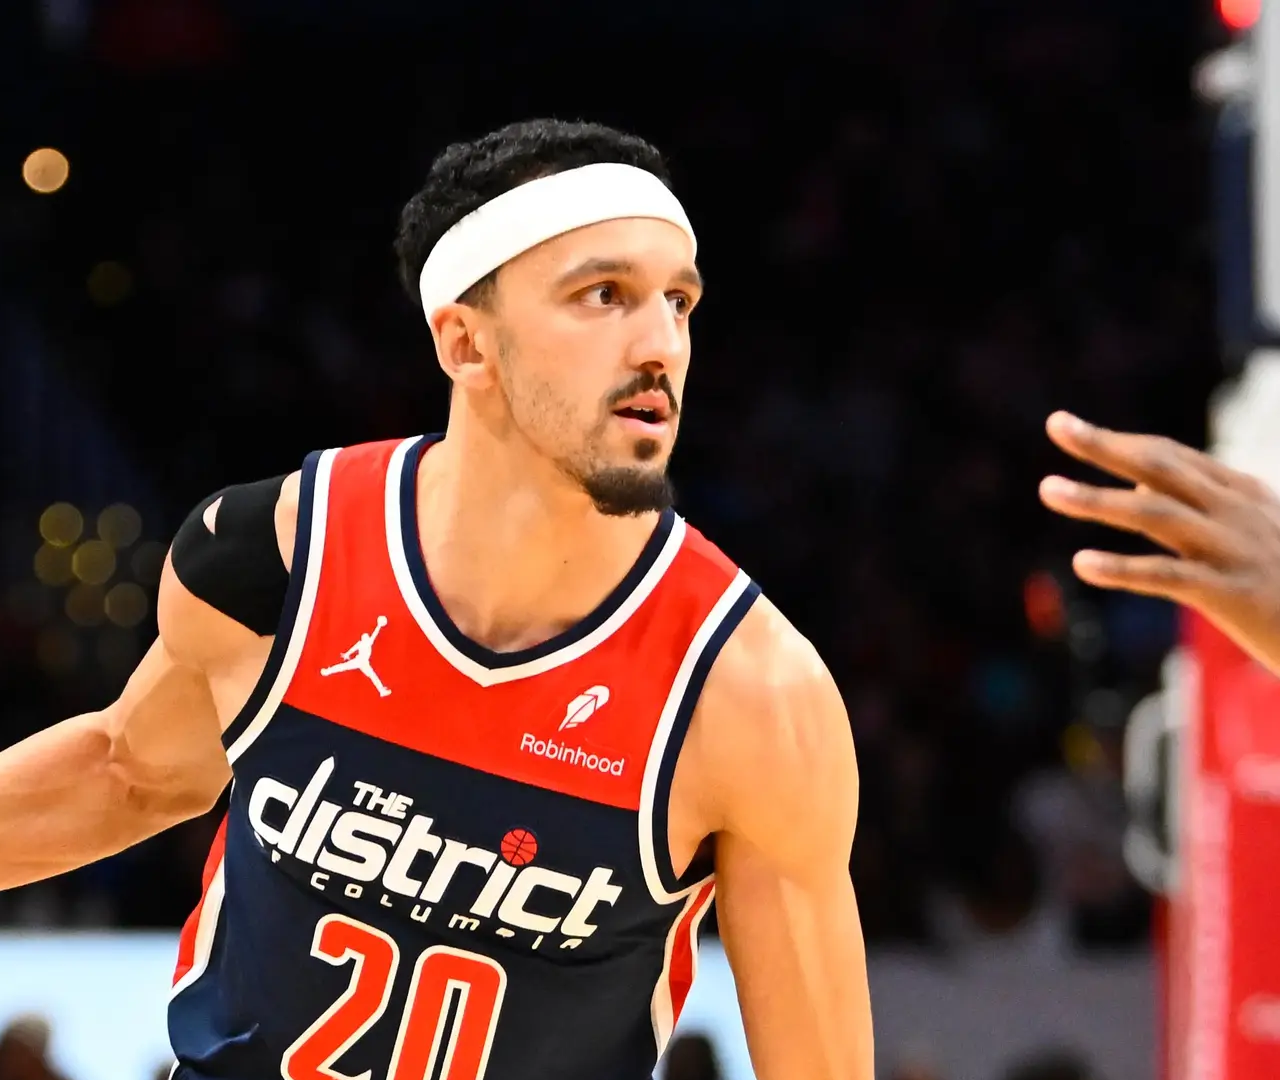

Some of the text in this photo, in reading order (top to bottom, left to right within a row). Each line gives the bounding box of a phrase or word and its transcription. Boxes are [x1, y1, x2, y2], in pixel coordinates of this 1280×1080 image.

[520, 733, 625, 777] Robinhood
[352, 780, 414, 820] THE
[248, 755, 624, 938] district
